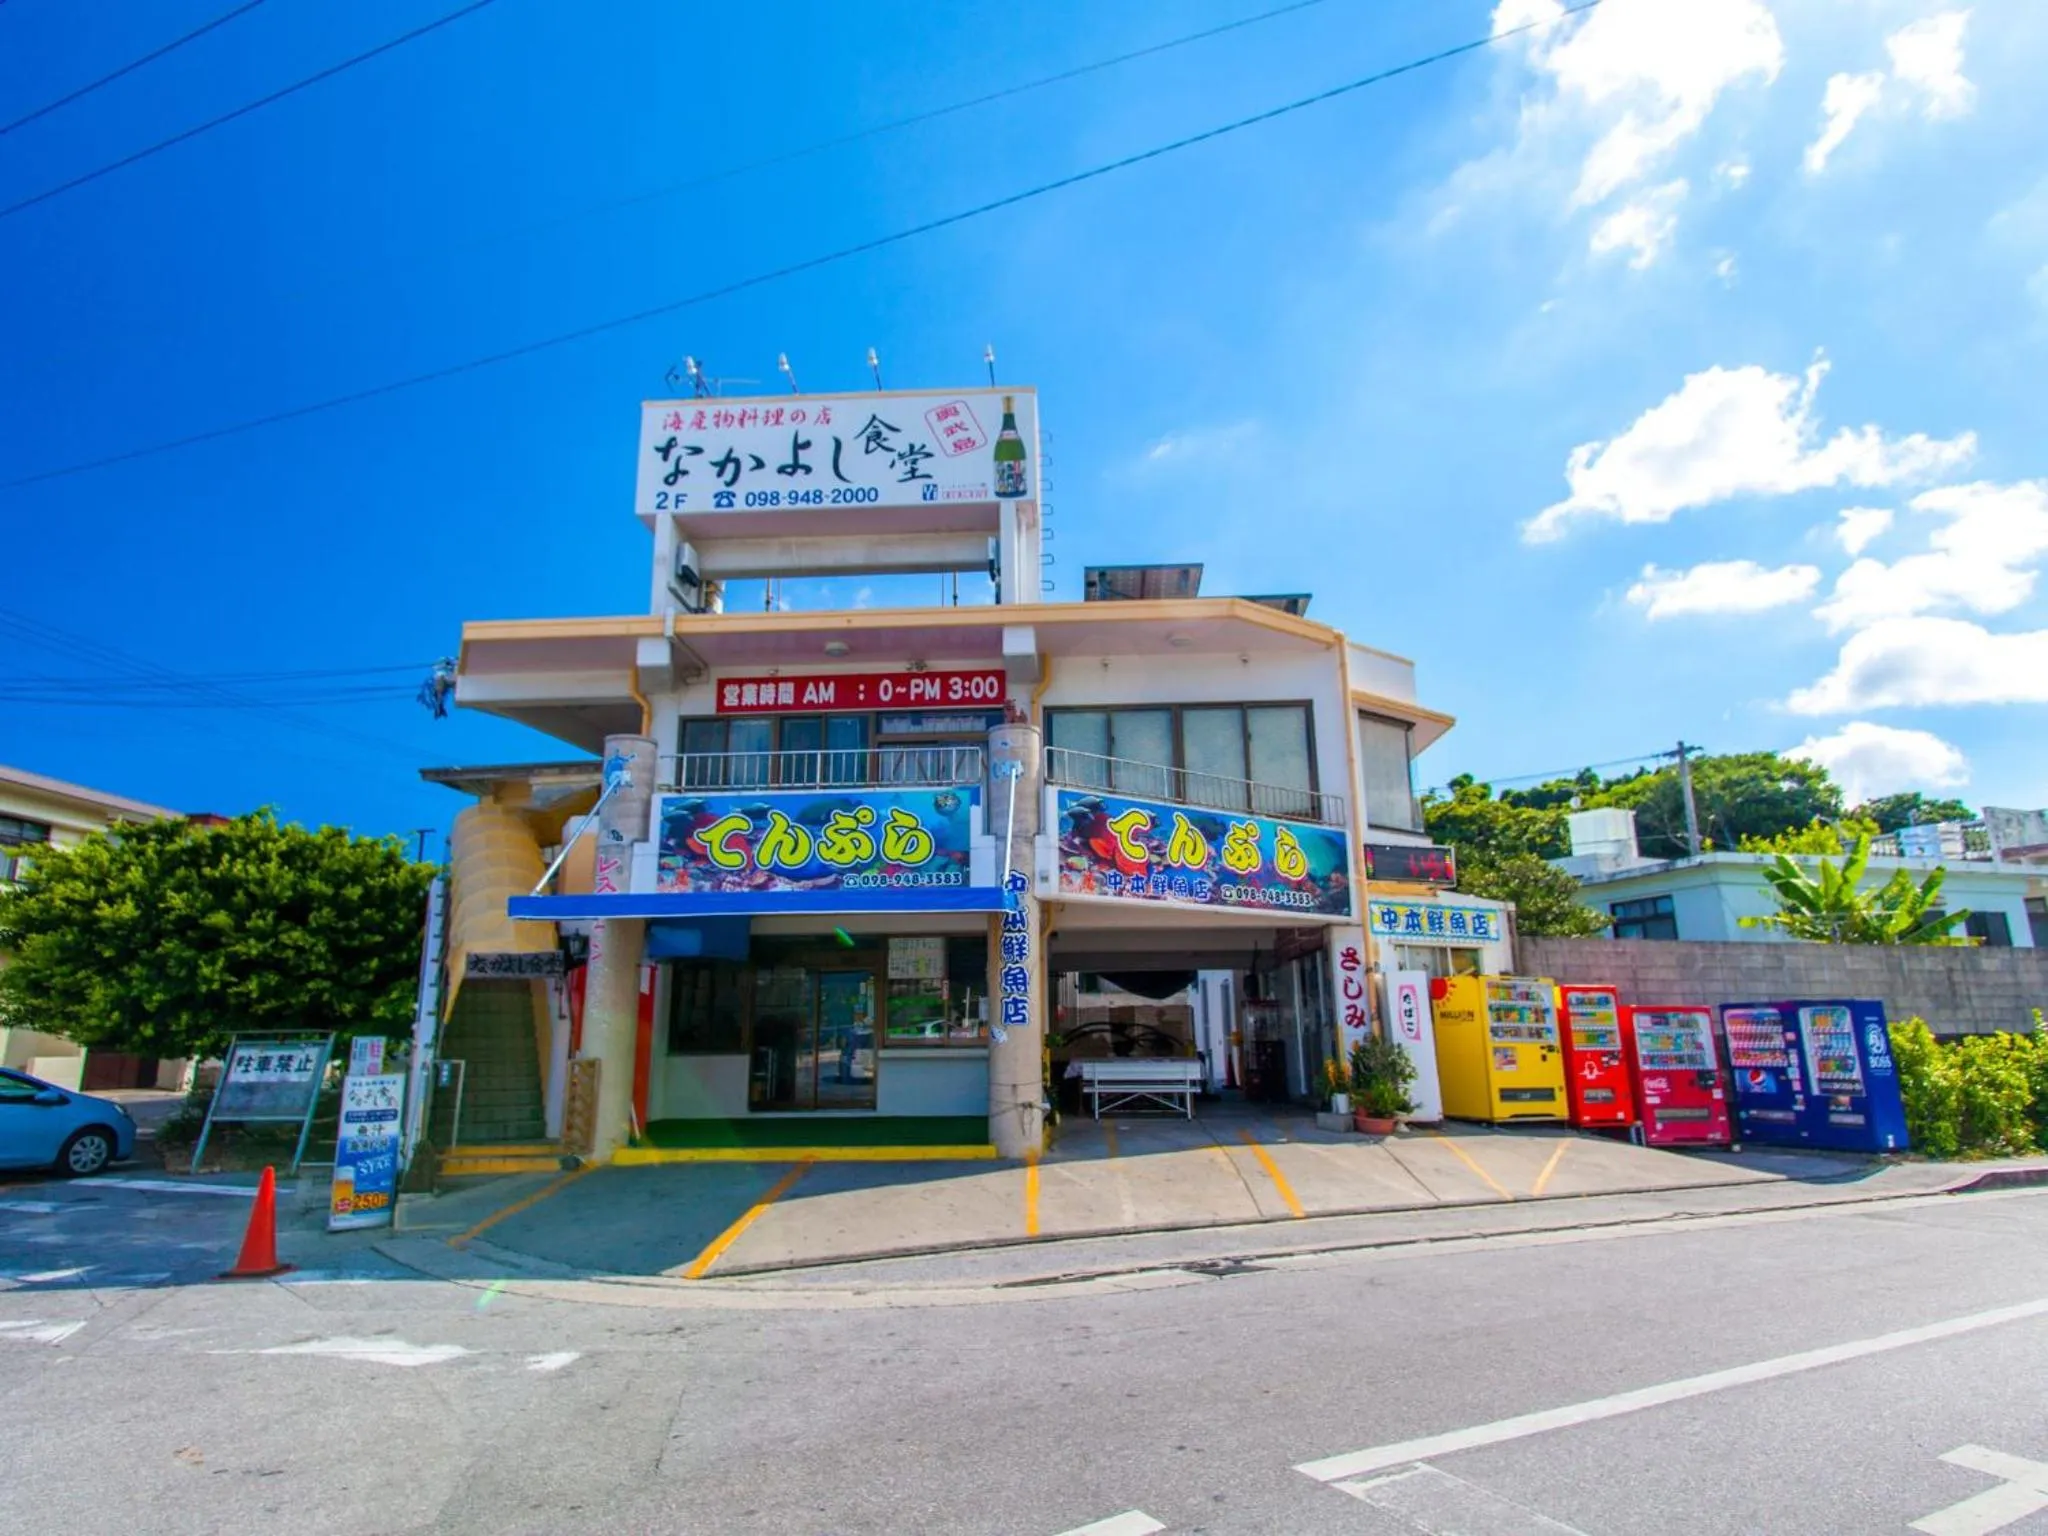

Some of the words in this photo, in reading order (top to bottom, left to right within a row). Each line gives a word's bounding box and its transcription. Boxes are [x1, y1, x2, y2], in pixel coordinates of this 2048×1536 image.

[662, 405, 832, 431] 海産物料理の店
[744, 487, 879, 507] 098-948-2000
[723, 682, 795, 707] 営業時間
[802, 681, 836, 705] AM
[948, 676, 999, 700] 3:00
[697, 807, 934, 867] てんぷら
[1107, 809, 1309, 880] てんぷら
[860, 872, 962, 887] 098-948-3583
[1105, 872, 1210, 900] 中本鮮魚店
[1380, 908, 1491, 936] 中本鮮魚店
[1402, 993, 1415, 1033] たばこ
[237, 1053, 313, 1074] 駐車禁止
